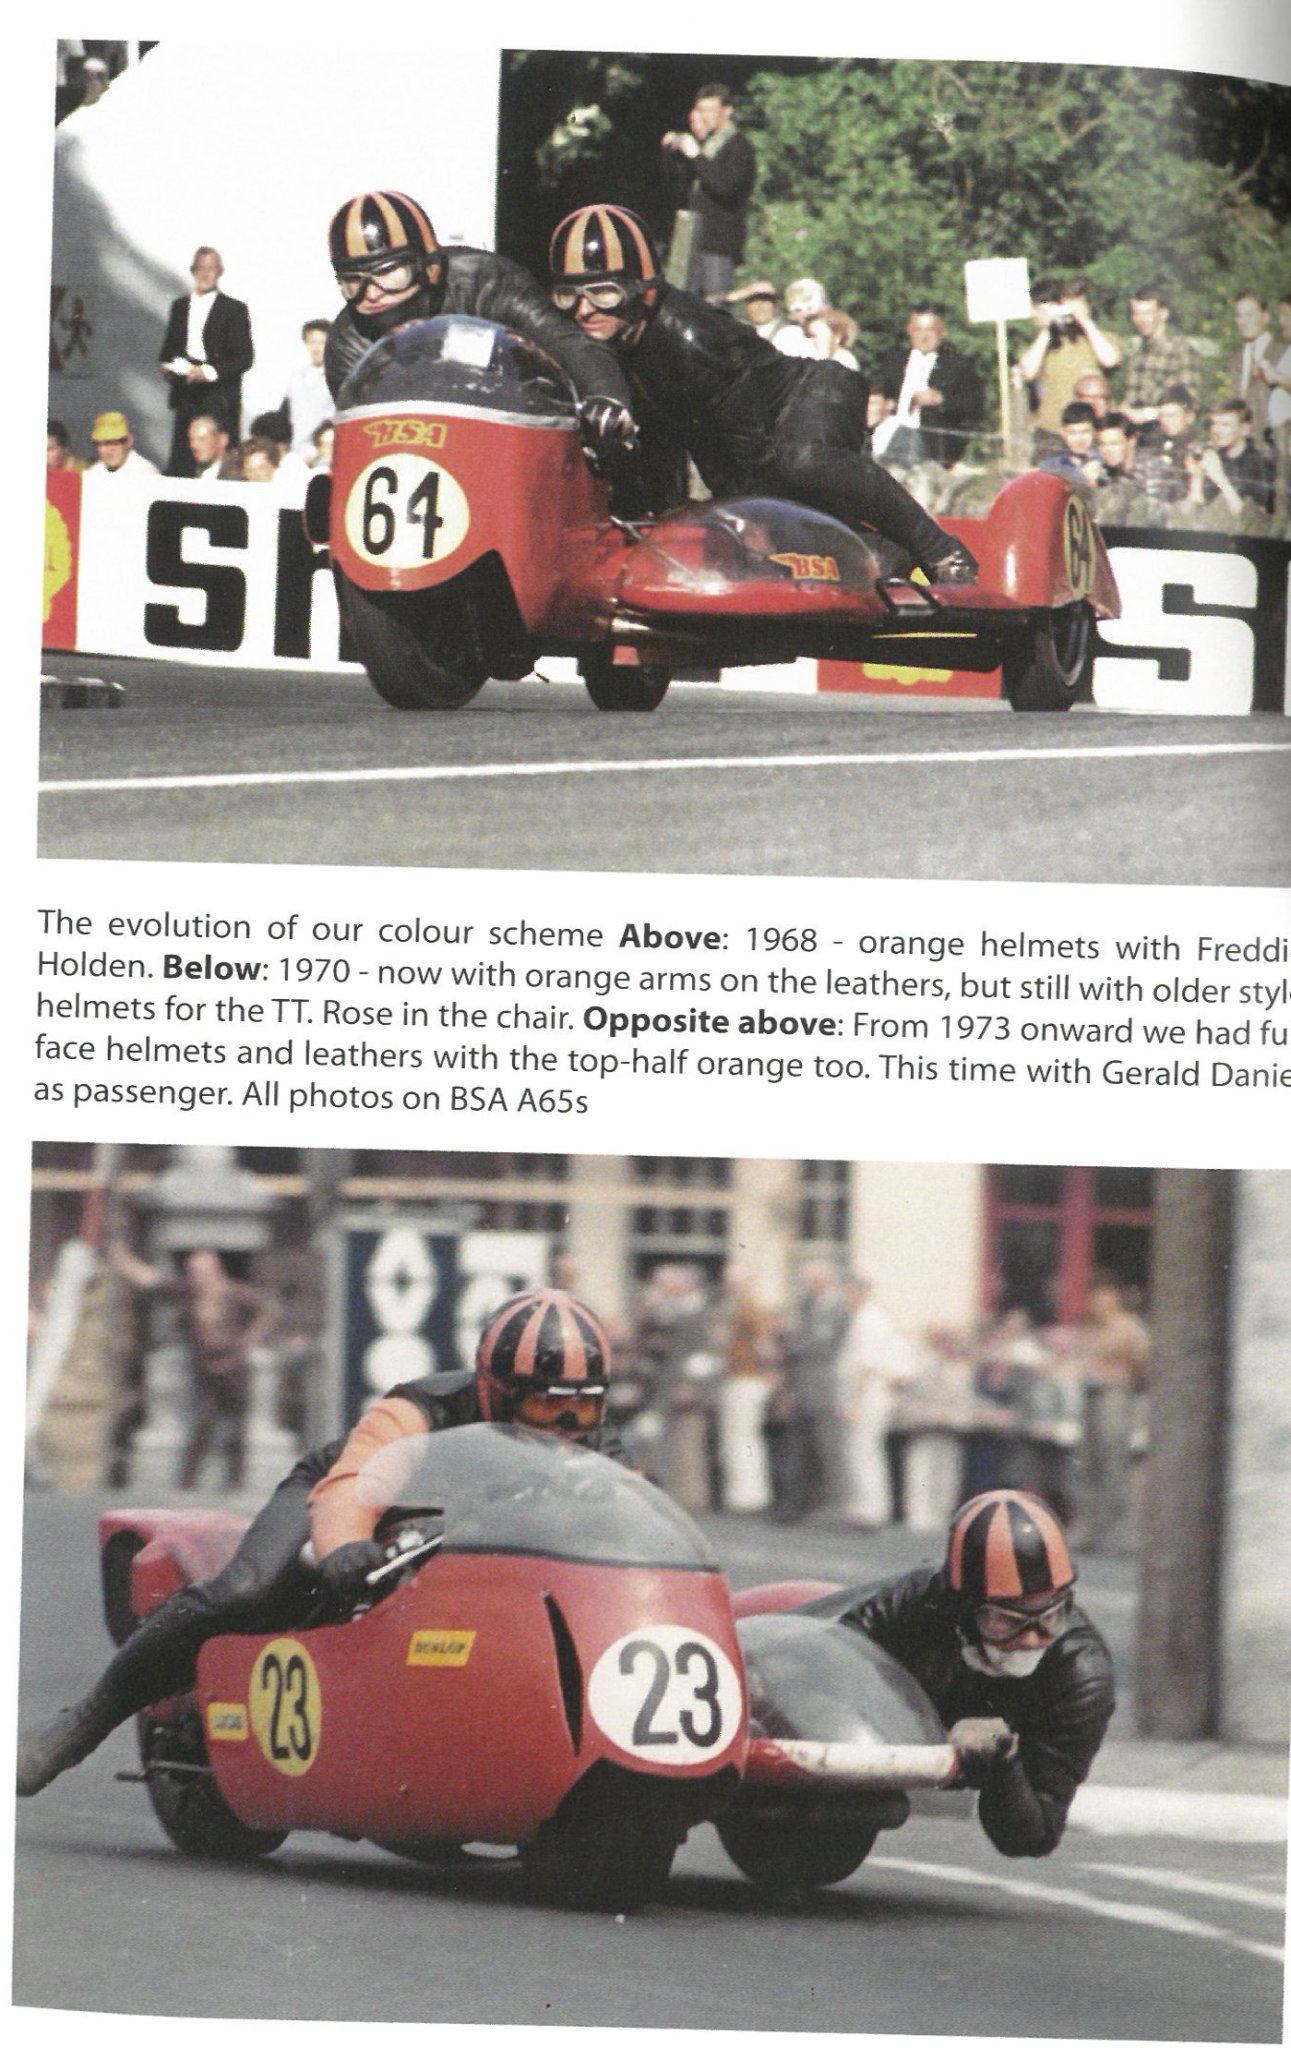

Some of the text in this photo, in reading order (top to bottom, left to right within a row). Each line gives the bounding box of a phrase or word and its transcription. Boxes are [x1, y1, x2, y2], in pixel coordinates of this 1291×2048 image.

[363, 466, 443, 559] 64
[768, 552, 840, 581] BSA
[1067, 501, 1091, 589] 64
[38, 909, 92, 935] The
[109, 912, 250, 938] evolution
[268, 914, 299, 939] of
[313, 923, 363, 941] our
[379, 918, 473, 944] colour
[490, 920, 603, 947] scheme
[619, 923, 728, 949] Above:
[748, 928, 817, 952] 1968
[859, 936, 964, 962] orange
[982, 931, 1099, 958] helmets
[1116, 935, 1179, 960] with
[1199, 937, 1291, 962] Freddi
[39, 951, 153, 978] Holden.
[164, 954, 268, 980] Below:
[281, 958, 350, 983] 1970
[379, 966, 442, 984] now
[451, 961, 515, 986] with
[526, 969, 630, 995] orange
[640, 972, 711, 991] arms
[721, 974, 757, 992] on
[768, 968, 816, 994] the
[827, 969, 950, 1000] leathers,
[962, 972, 1011, 998] but
[1021, 974, 1069, 999] still
[1079, 976, 1142, 1001] with
[1153, 977, 1230, 1003] older
[1240, 979, 1291, 1011] styl
[38, 992, 1287, 1045] helmets for the TT. Rose in the chair. Opposite above: From 1973 onward we had fu
[35, 1033, 95, 1060] face
[108, 1035, 225, 1063] helmets
[238, 1040, 292, 1065] and
[306, 1040, 422, 1068] leathers
[434, 1044, 497, 1069] with
[510, 1045, 557, 1071] the
[568, 1048, 689, 1079] top-half
[698, 1057, 802, 1083] orange
[814, 1056, 869, 1078] too.
[879, 1054, 937, 1080] This
[949, 1057, 1015, 1082] time
[1027, 1058, 1090, 1083] with
[1103, 1060, 1199, 1086] Gerald
[34, 1081, 587, 1113] as passenger. All photos on BSA A65s
[262, 1653, 311, 1761] 23
[618, 1640, 722, 1748] 23
